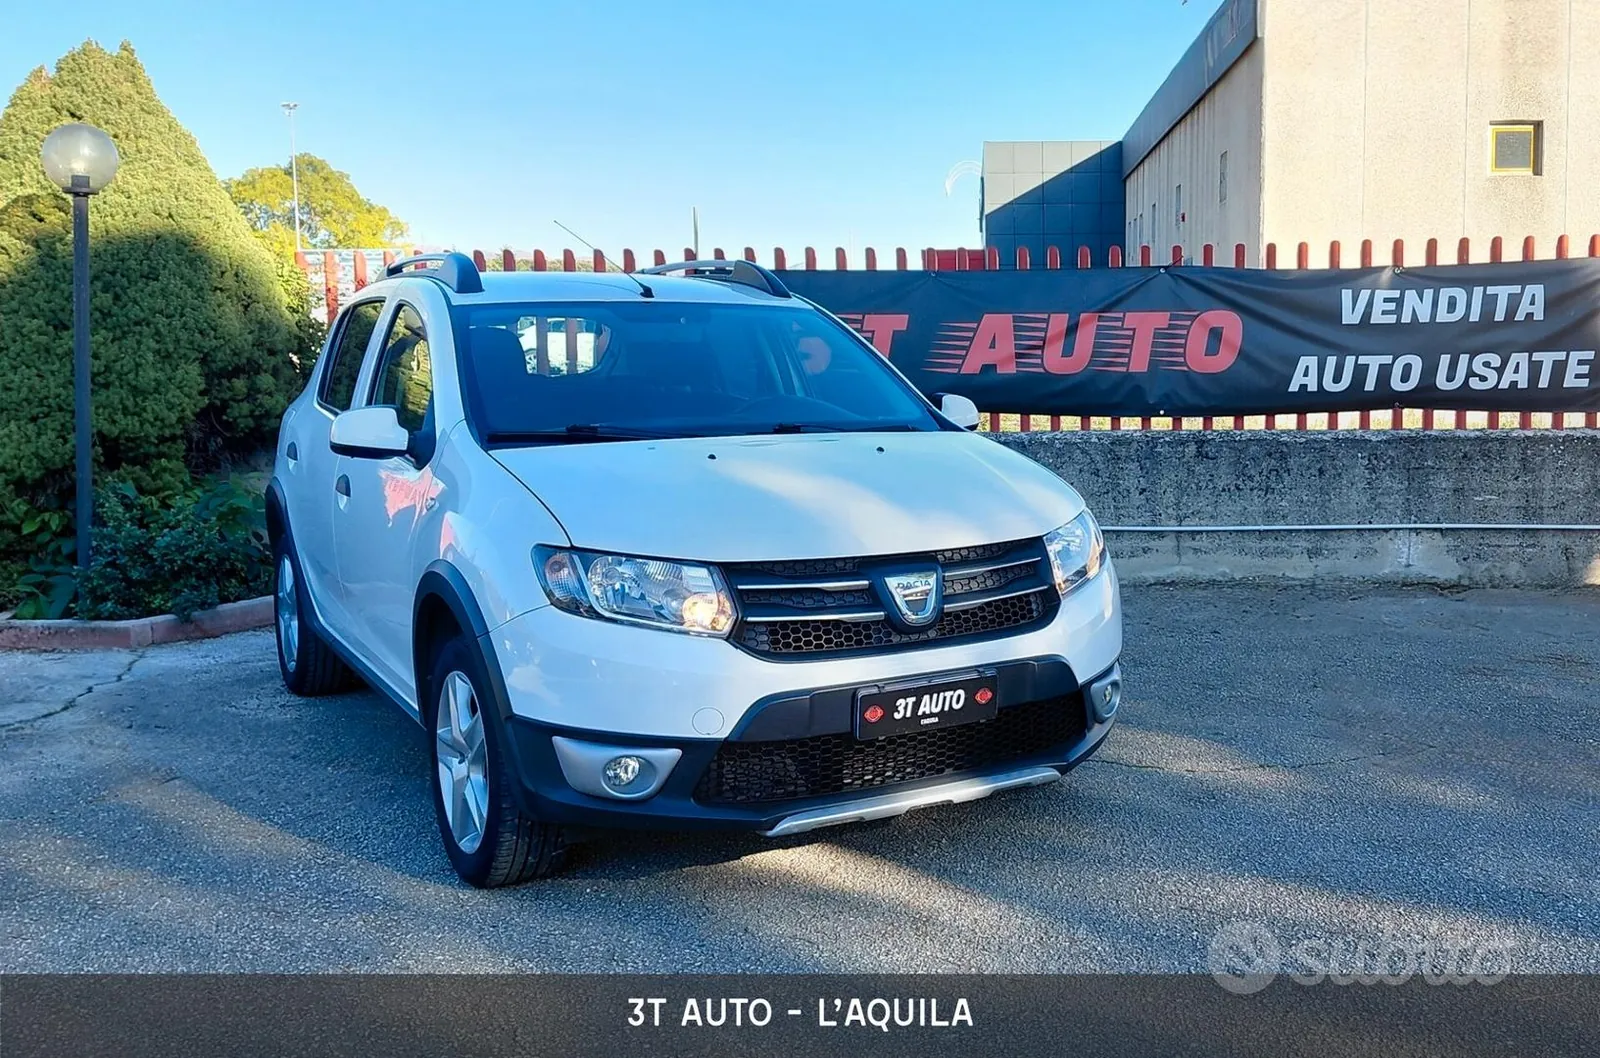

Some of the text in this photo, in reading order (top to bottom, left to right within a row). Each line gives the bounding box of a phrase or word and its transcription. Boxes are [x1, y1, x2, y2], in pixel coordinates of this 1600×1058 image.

[1341, 284, 1545, 325] VENDITA
[957, 310, 1244, 374] AUTO
[1287, 351, 1596, 393] AUTO USATE
[896, 580, 931, 590] DACIA
[893, 689, 966, 720] 3T AUTO
